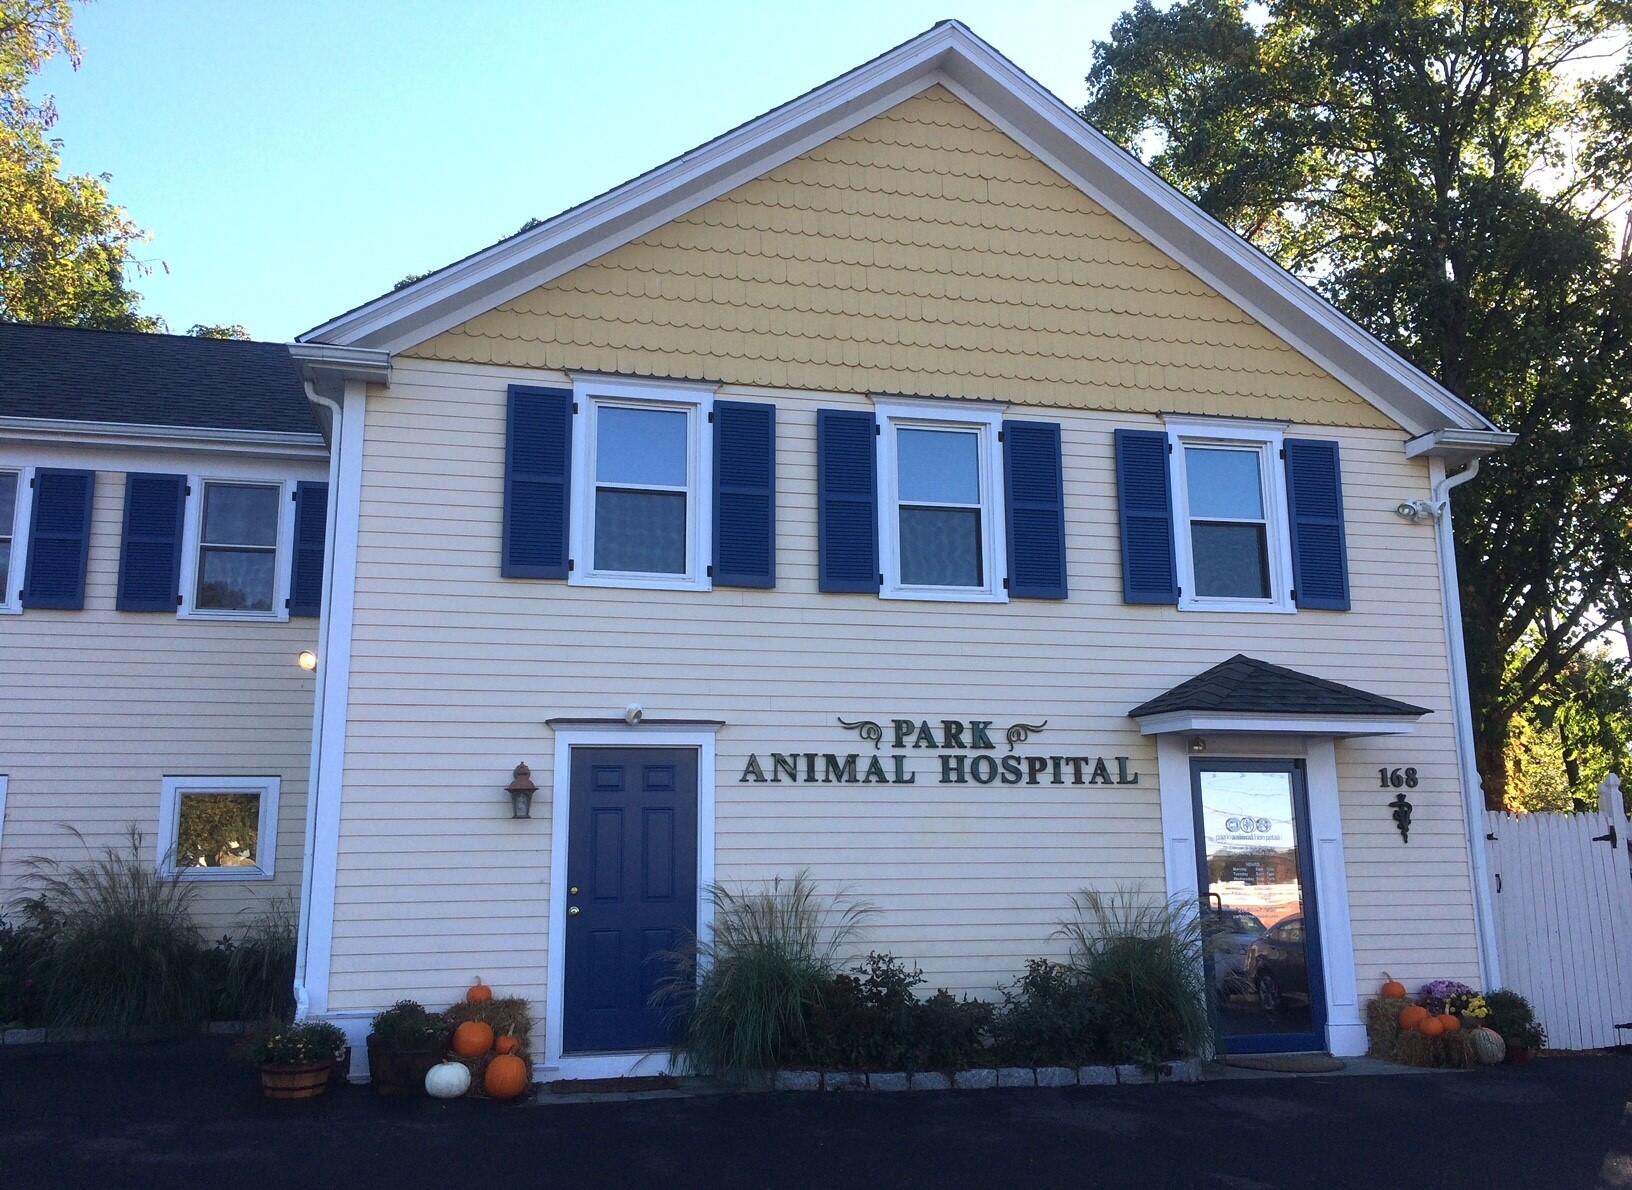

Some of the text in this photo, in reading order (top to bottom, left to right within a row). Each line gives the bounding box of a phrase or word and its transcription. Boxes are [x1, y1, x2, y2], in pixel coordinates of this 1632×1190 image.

[891, 719, 997, 749] PARK
[739, 752, 1139, 785] ANIMAL HOSPITAL
[1378, 767, 1419, 788] 168
